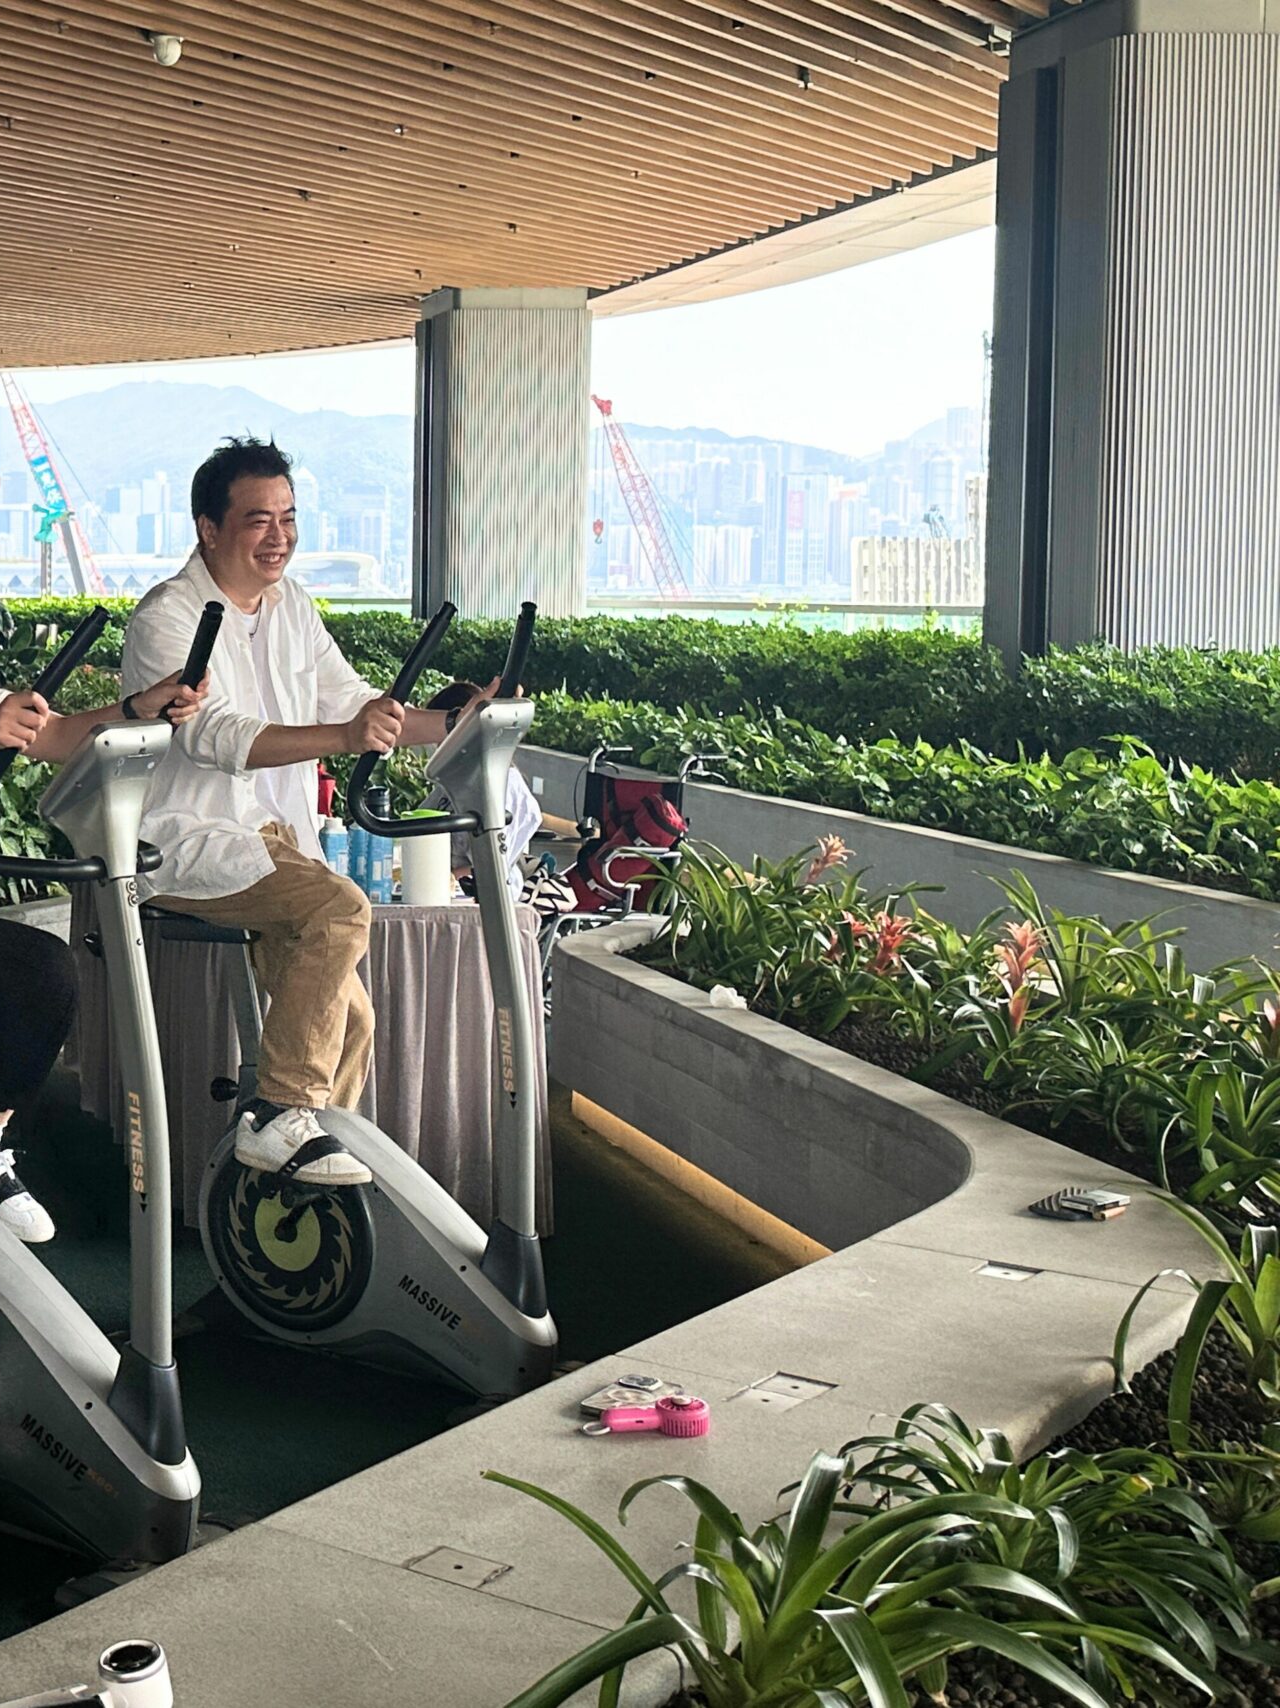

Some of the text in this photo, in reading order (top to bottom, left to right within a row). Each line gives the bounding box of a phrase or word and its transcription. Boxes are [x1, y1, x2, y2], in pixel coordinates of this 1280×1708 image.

[497, 1006, 515, 1093] FITNESS
[127, 1090, 145, 1194] FITNESS
[398, 1274, 462, 1331] MASSIVE
[20, 1413, 89, 1482] MASSIVE
